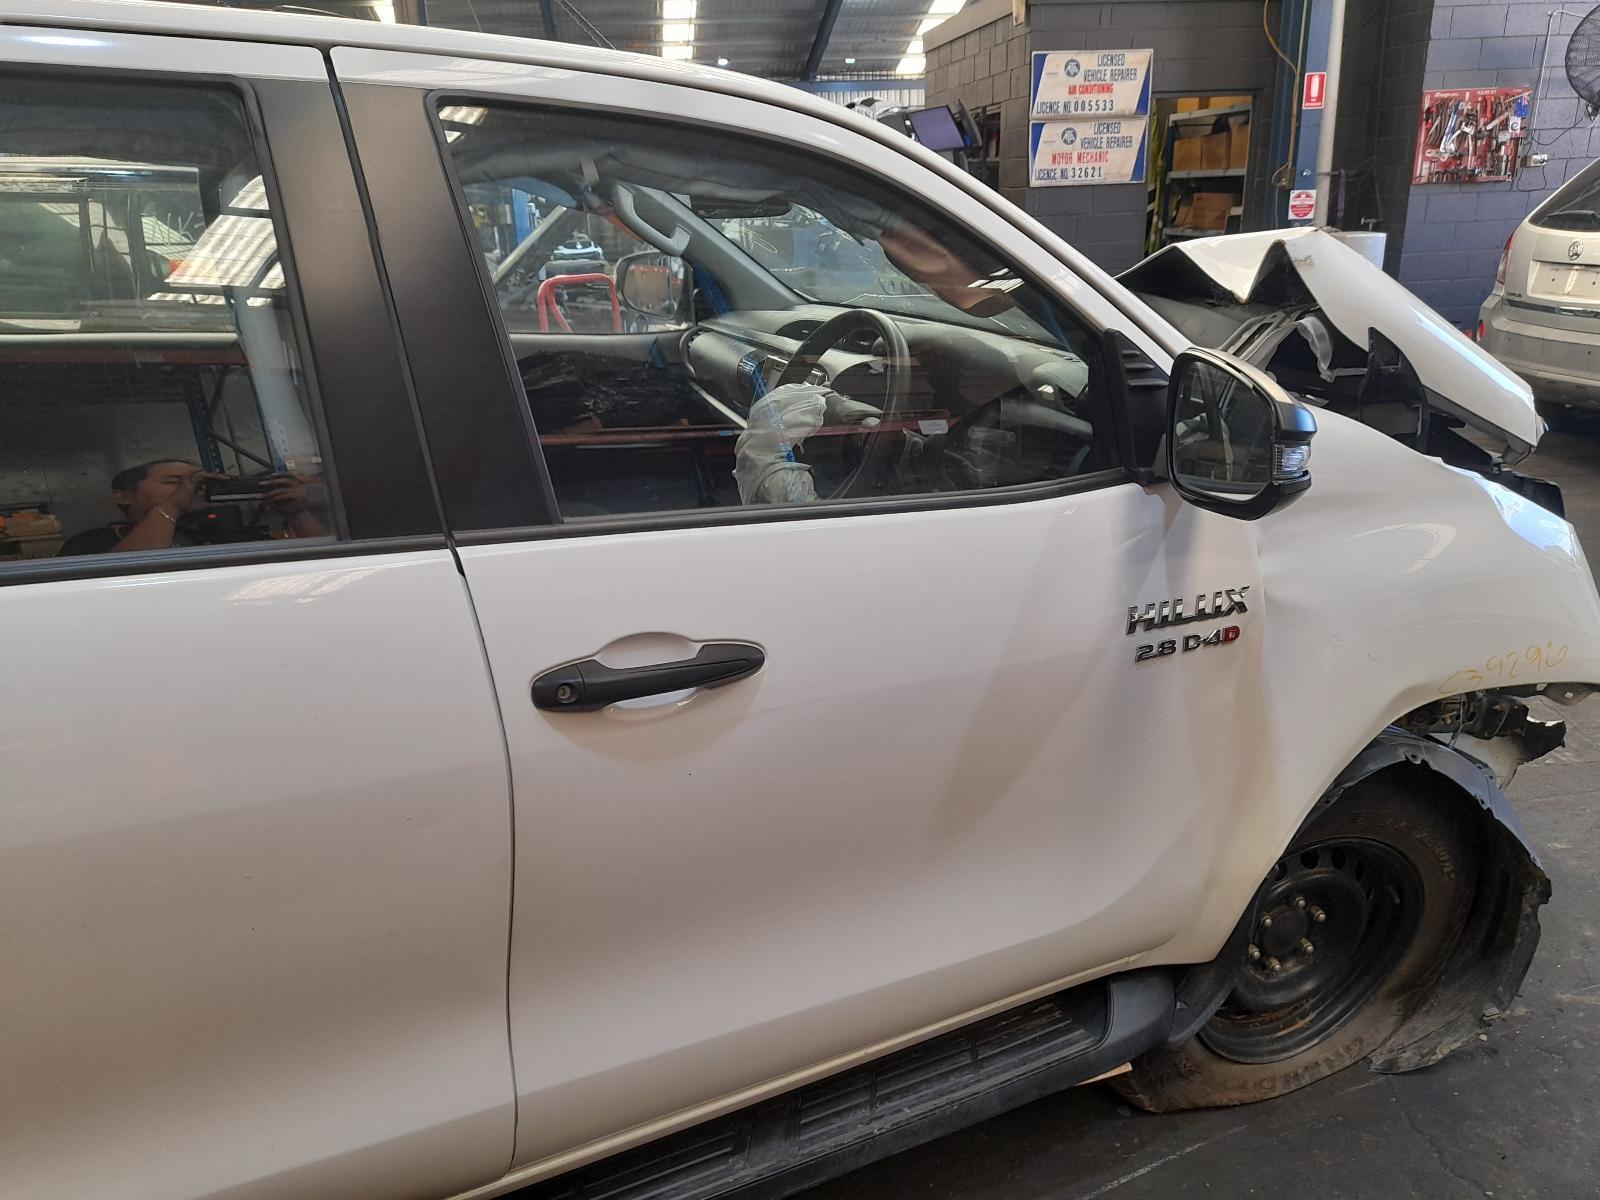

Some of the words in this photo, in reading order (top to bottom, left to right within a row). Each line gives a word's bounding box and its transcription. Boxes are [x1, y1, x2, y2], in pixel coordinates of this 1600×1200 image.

[1097, 53, 1125, 67] LICENSED
[1083, 69, 1107, 82] VEHICLE
[1109, 68, 1138, 81] REPAIRER
[1068, 84, 1077, 95] AIR
[1078, 83, 1114, 95] CONDITIONING
[1036, 101, 1060, 114] LICENCE
[1073, 100, 1114, 112] 005533
[1093, 122, 1121, 135] LICENSED
[1080, 137, 1103, 149] VEHICLE
[1105, 136, 1133, 149] REPAIRER
[1051, 152, 1073, 165] MOTOR
[1076, 151, 1109, 164] MECHANIC
[1035, 168, 1057, 181] LICENCE
[1070, 166, 1102, 179] 32621
[1126, 585, 1250, 635] HILUX
[1135, 638, 1177, 663] 2.8
[1182, 625, 1241, 653] D-4D
